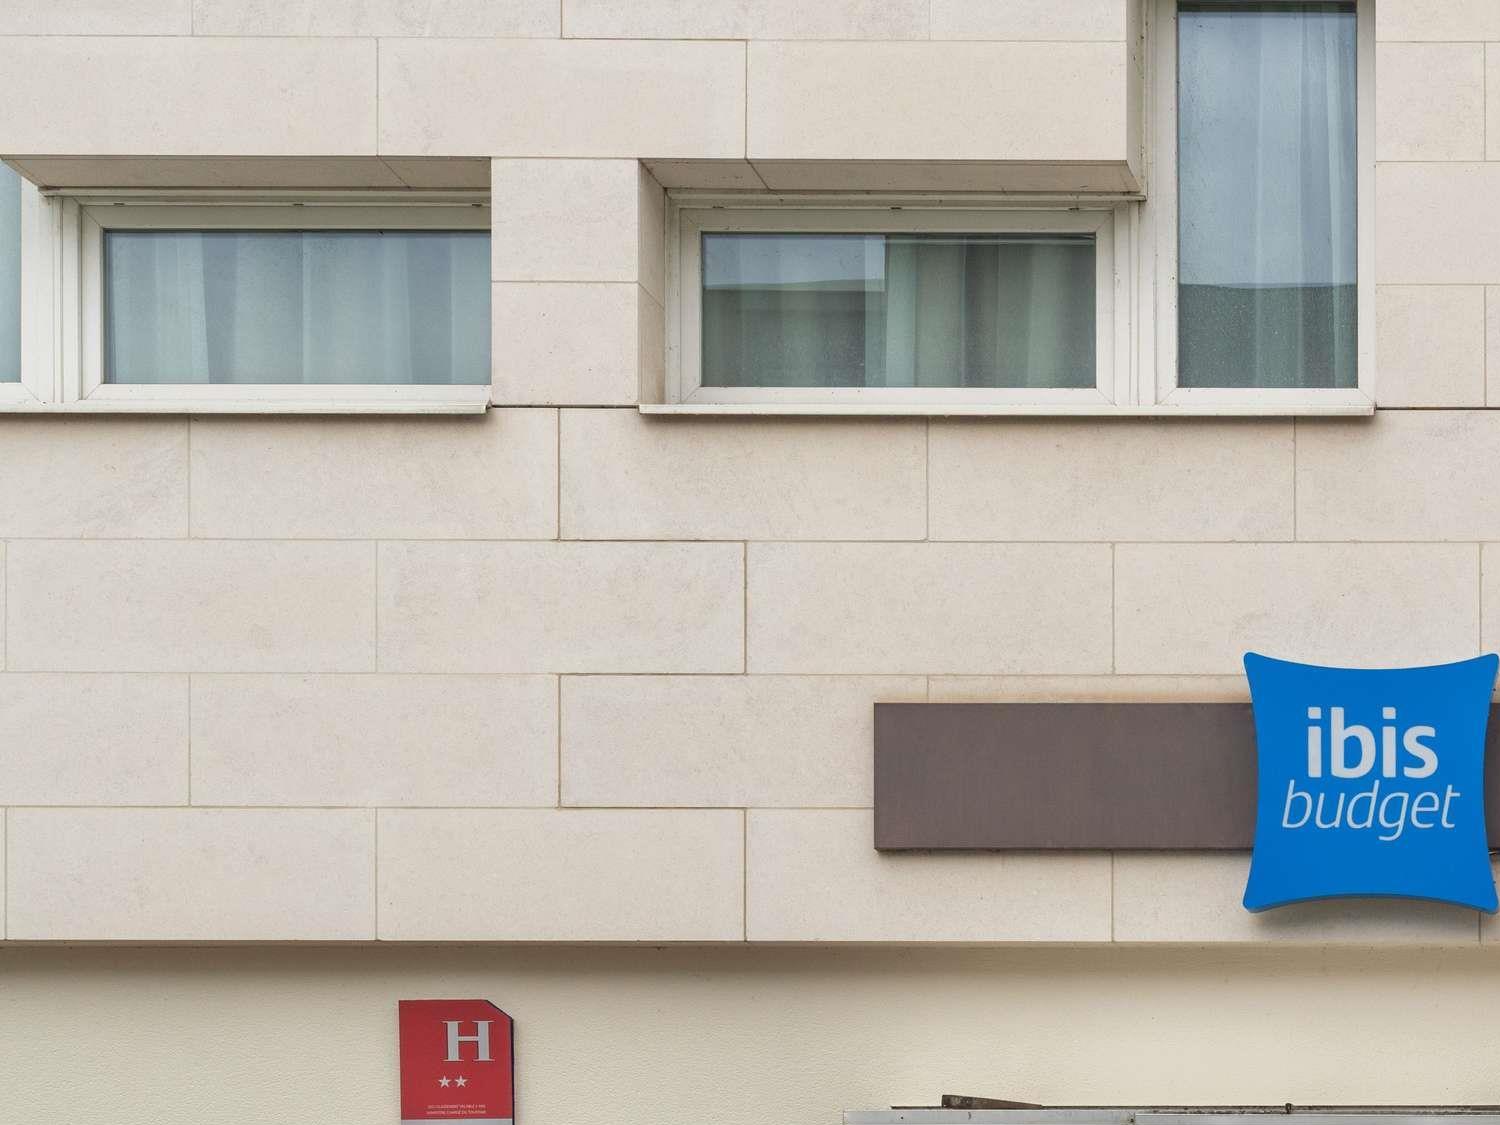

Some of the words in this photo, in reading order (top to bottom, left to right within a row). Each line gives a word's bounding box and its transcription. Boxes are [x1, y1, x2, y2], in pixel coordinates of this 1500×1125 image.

[1307, 706, 1439, 779] ibis
[1282, 779, 1461, 841] budget
[441, 1020, 496, 1062] H
